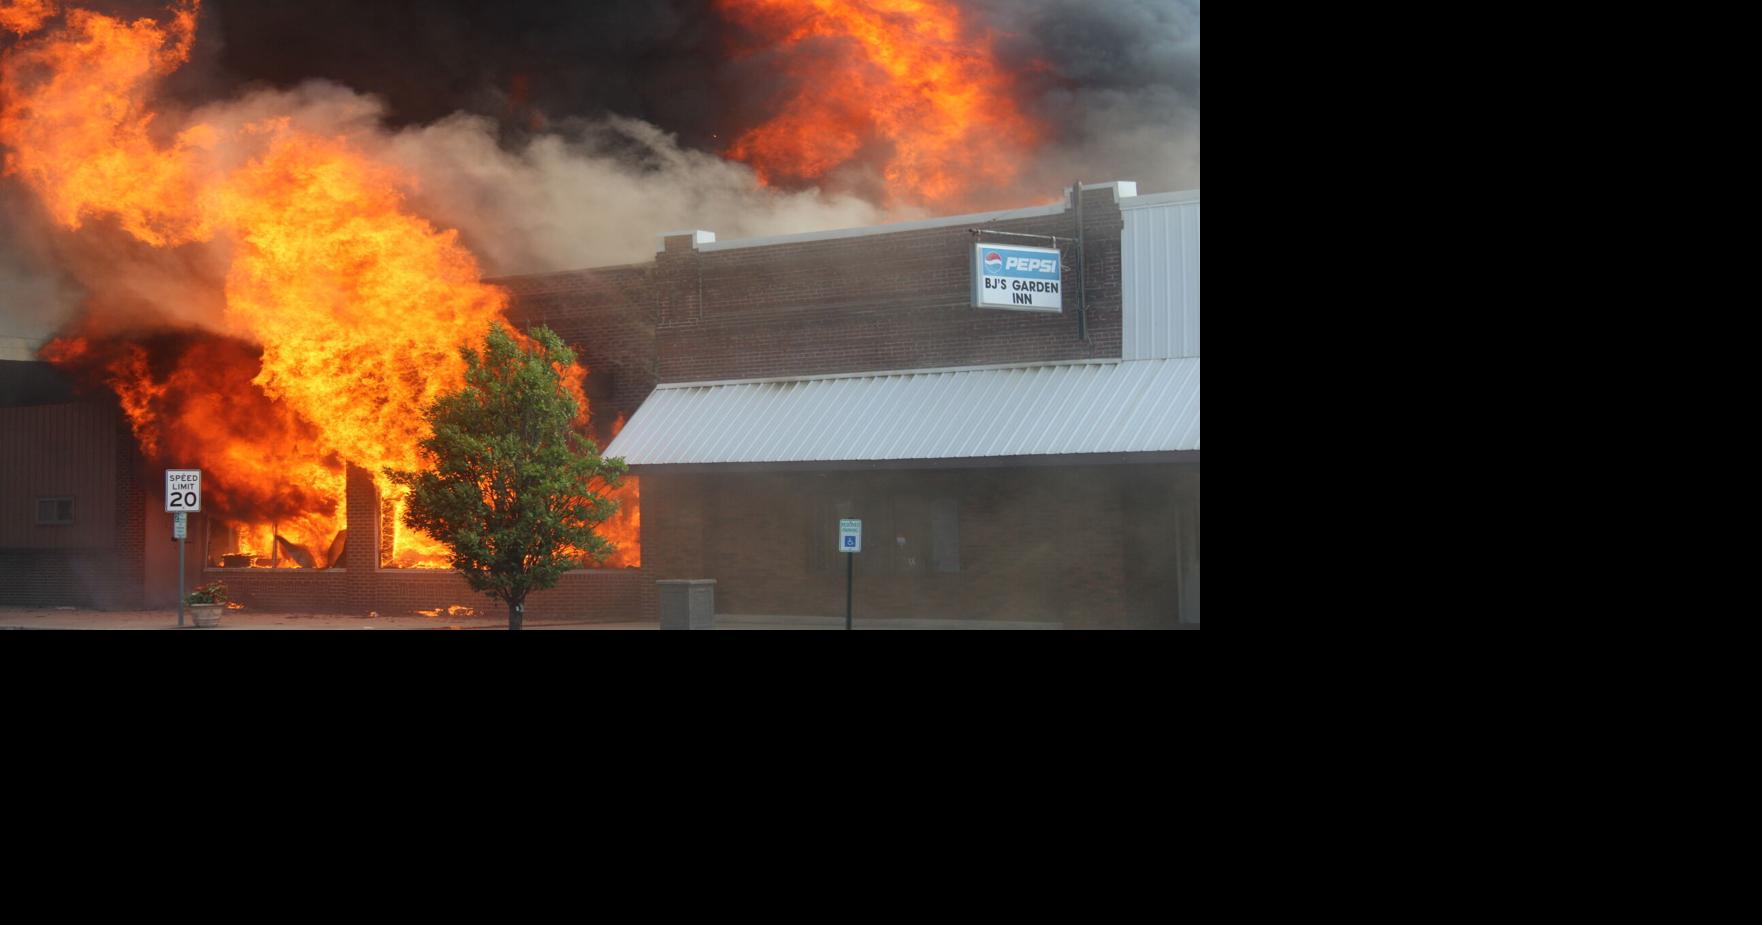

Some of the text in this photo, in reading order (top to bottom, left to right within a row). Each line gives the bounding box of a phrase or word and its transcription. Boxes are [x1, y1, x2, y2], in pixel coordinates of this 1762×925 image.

[1006, 256, 1057, 273] PEPSI
[985, 277, 1059, 293] BJ'S GARDEN
[1012, 292, 1033, 305] INN
[169, 474, 198, 482] SPEED
[170, 491, 197, 507] 20
